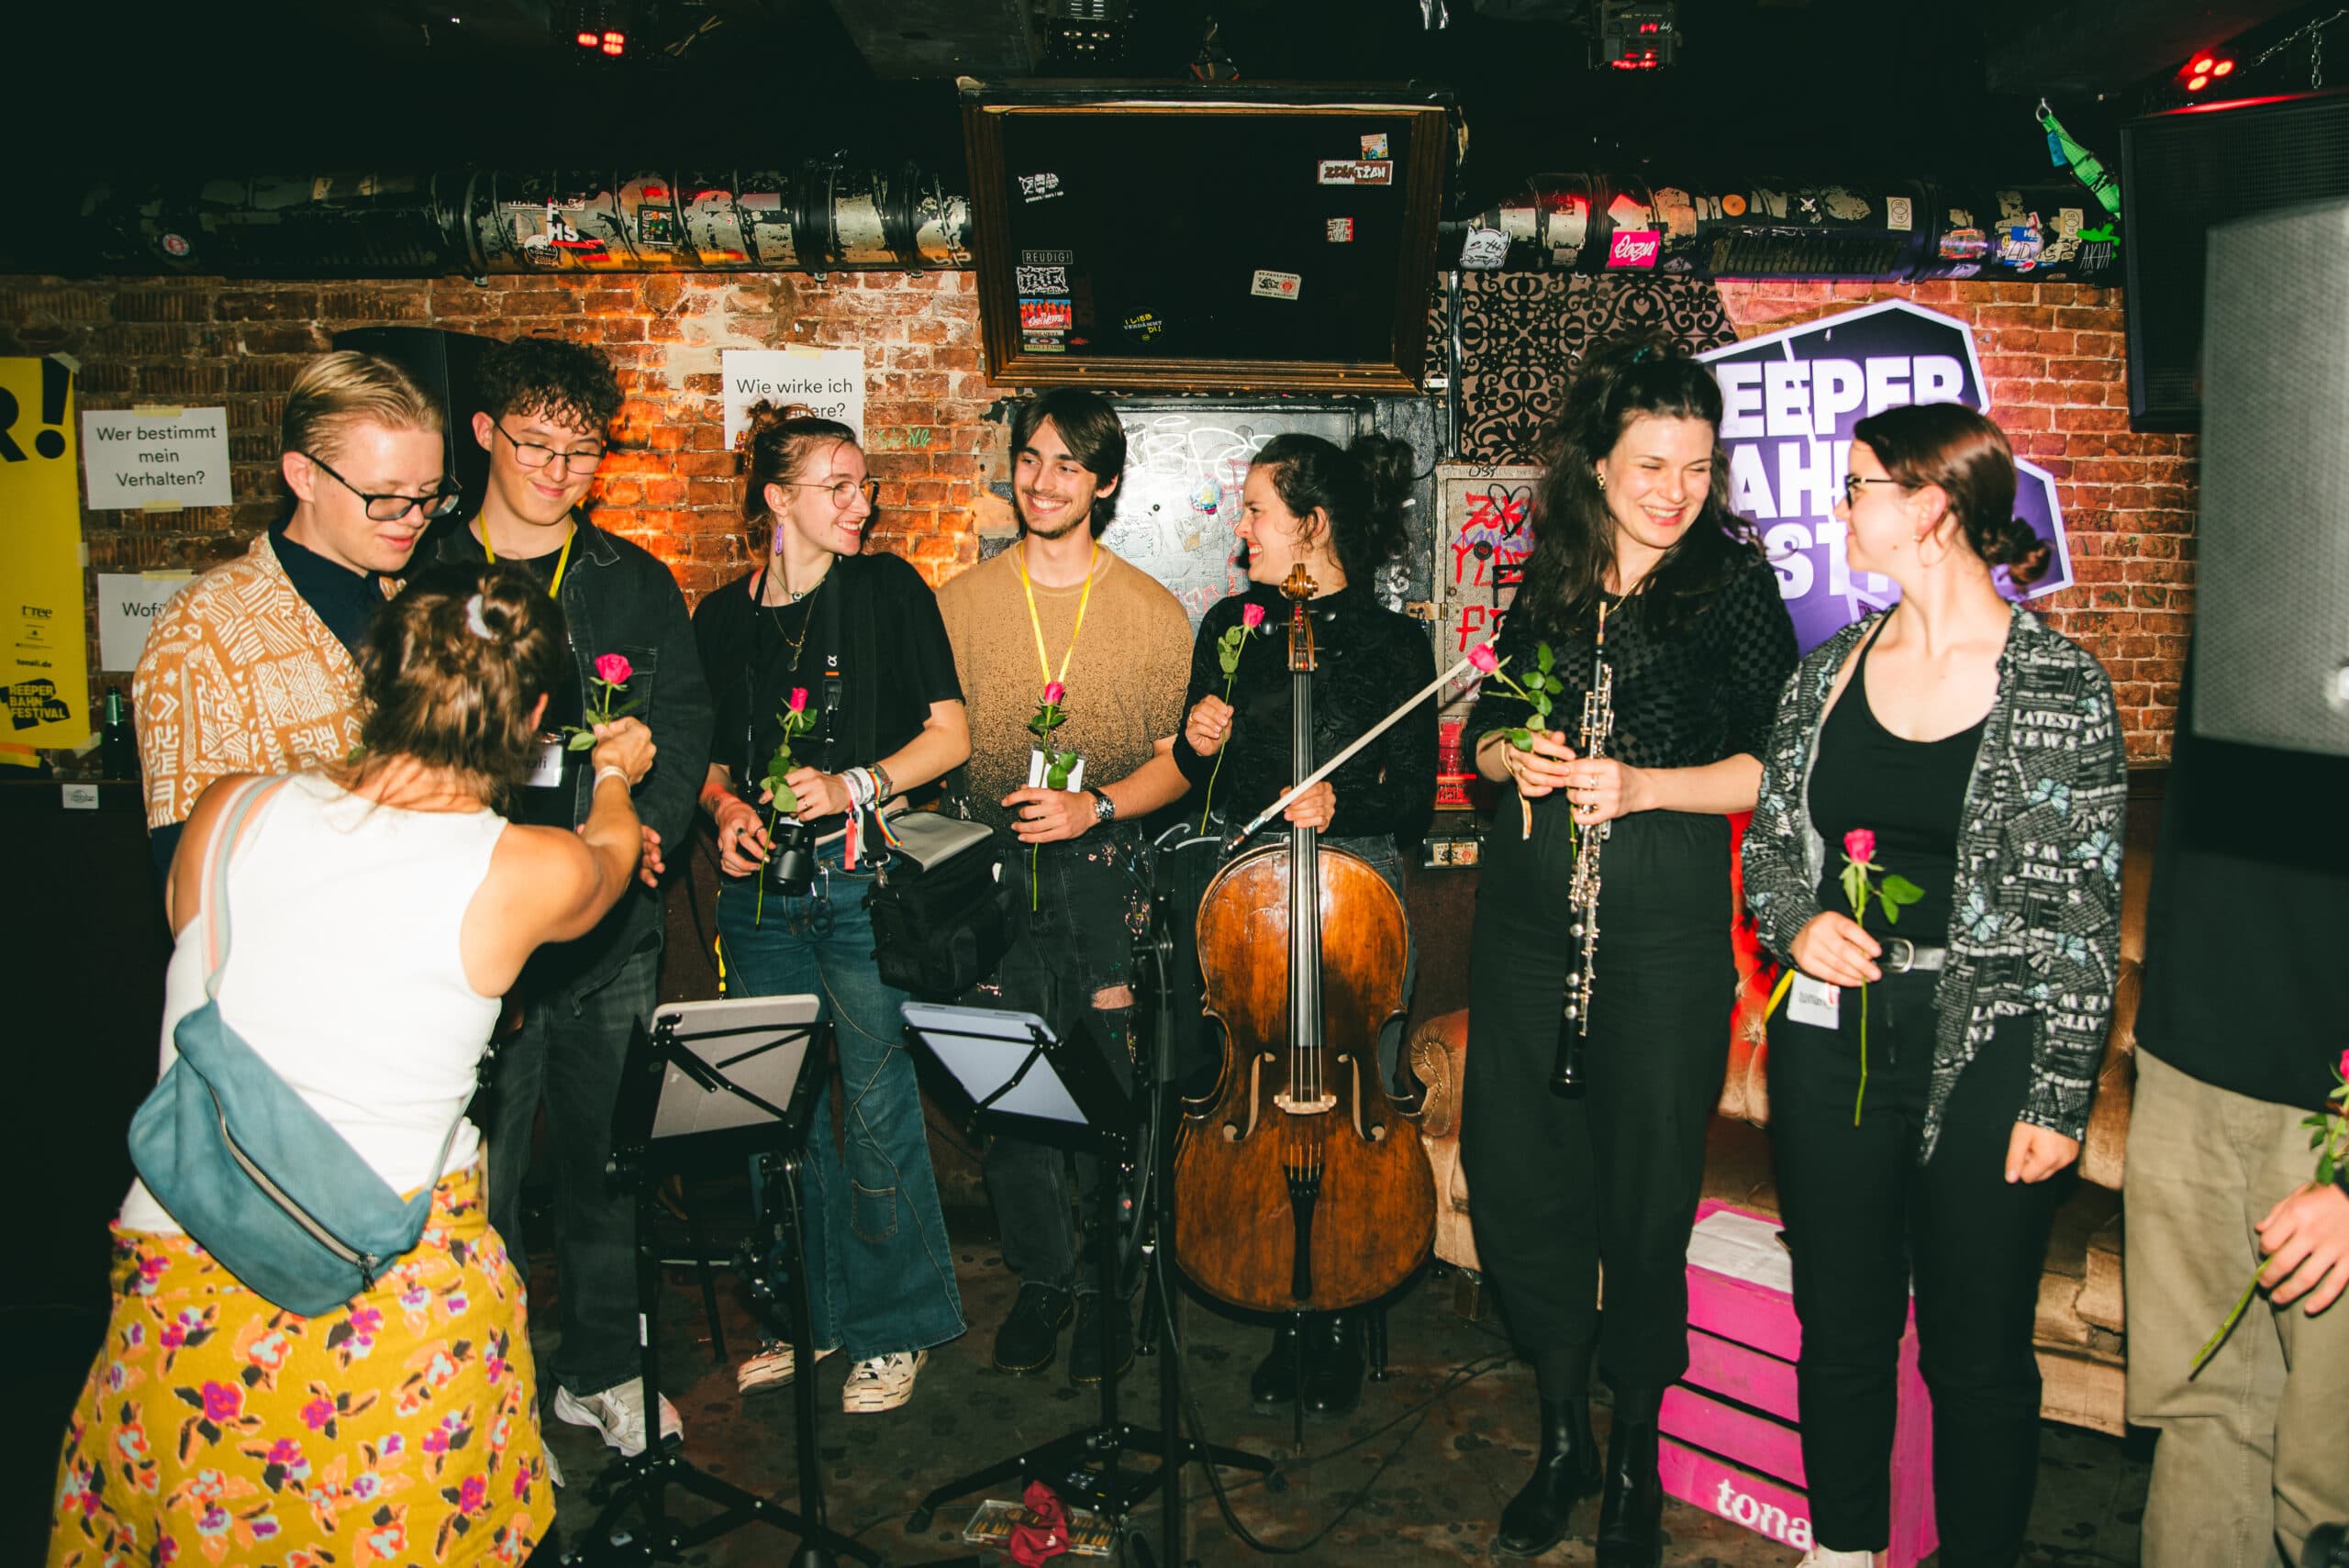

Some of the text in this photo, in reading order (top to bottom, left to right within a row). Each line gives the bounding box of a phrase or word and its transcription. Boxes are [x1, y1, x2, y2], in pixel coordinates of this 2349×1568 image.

[1026, 252, 1070, 263] REUDIG!
[736, 378, 852, 394] Wie wirke ich
[1716, 354, 1965, 439] EEPER
[96, 425, 217, 441] Wer bestimmt
[139, 448, 180, 463] mein
[116, 470, 206, 487] Verhalten?
[121, 601, 165, 617] Wof
[10, 685, 54, 695] REEPER
[9, 695, 43, 706] BAHN
[11, 707, 67, 718] FESTIVAL
[2012, 708, 2083, 730] LATEST
[1717, 1478, 1812, 1551] tona
